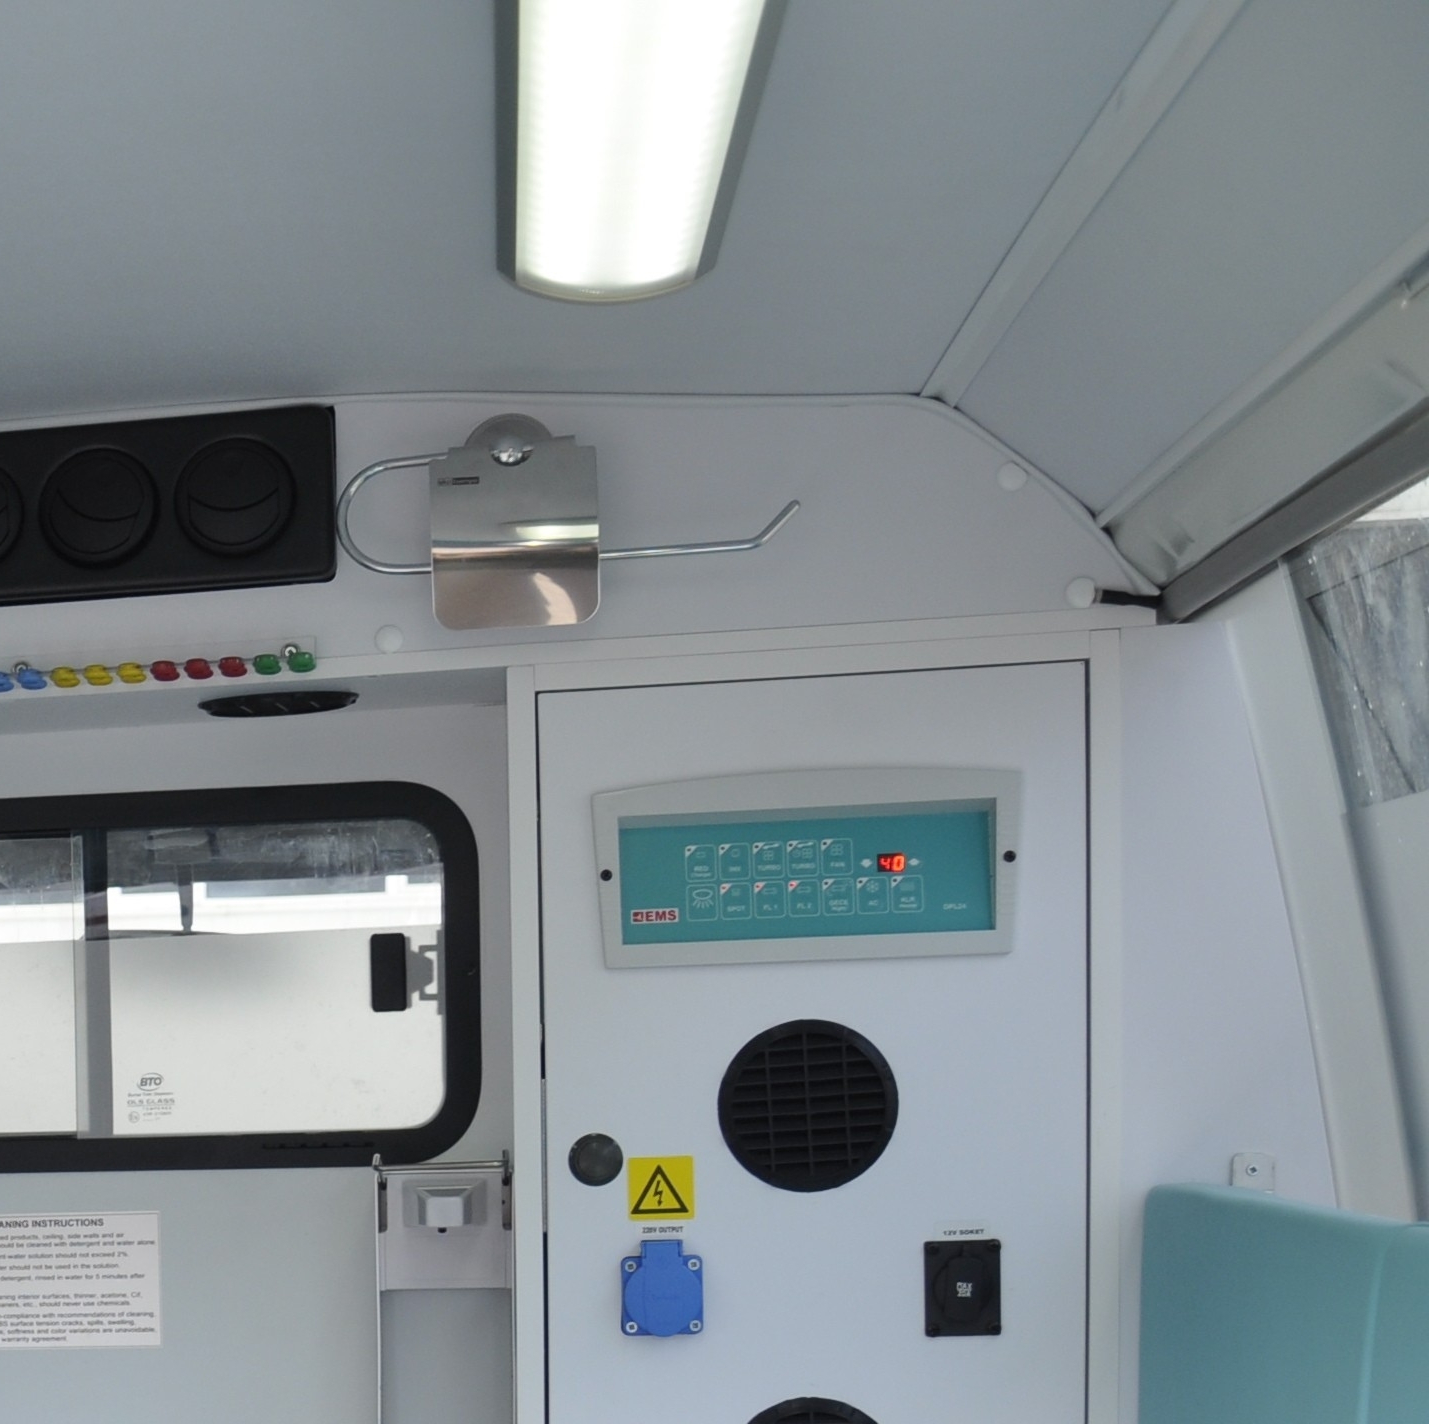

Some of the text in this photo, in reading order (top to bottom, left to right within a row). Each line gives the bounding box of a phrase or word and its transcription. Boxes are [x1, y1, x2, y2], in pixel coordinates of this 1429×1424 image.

[880, 855, 905, 871] 40
[645, 910, 677, 922] EMS
[140, 1077, 162, 1087] BTO
[31, 1218, 104, 1227] INSTRUCTIONS
[69, 1240, 100, 1248] detergent
